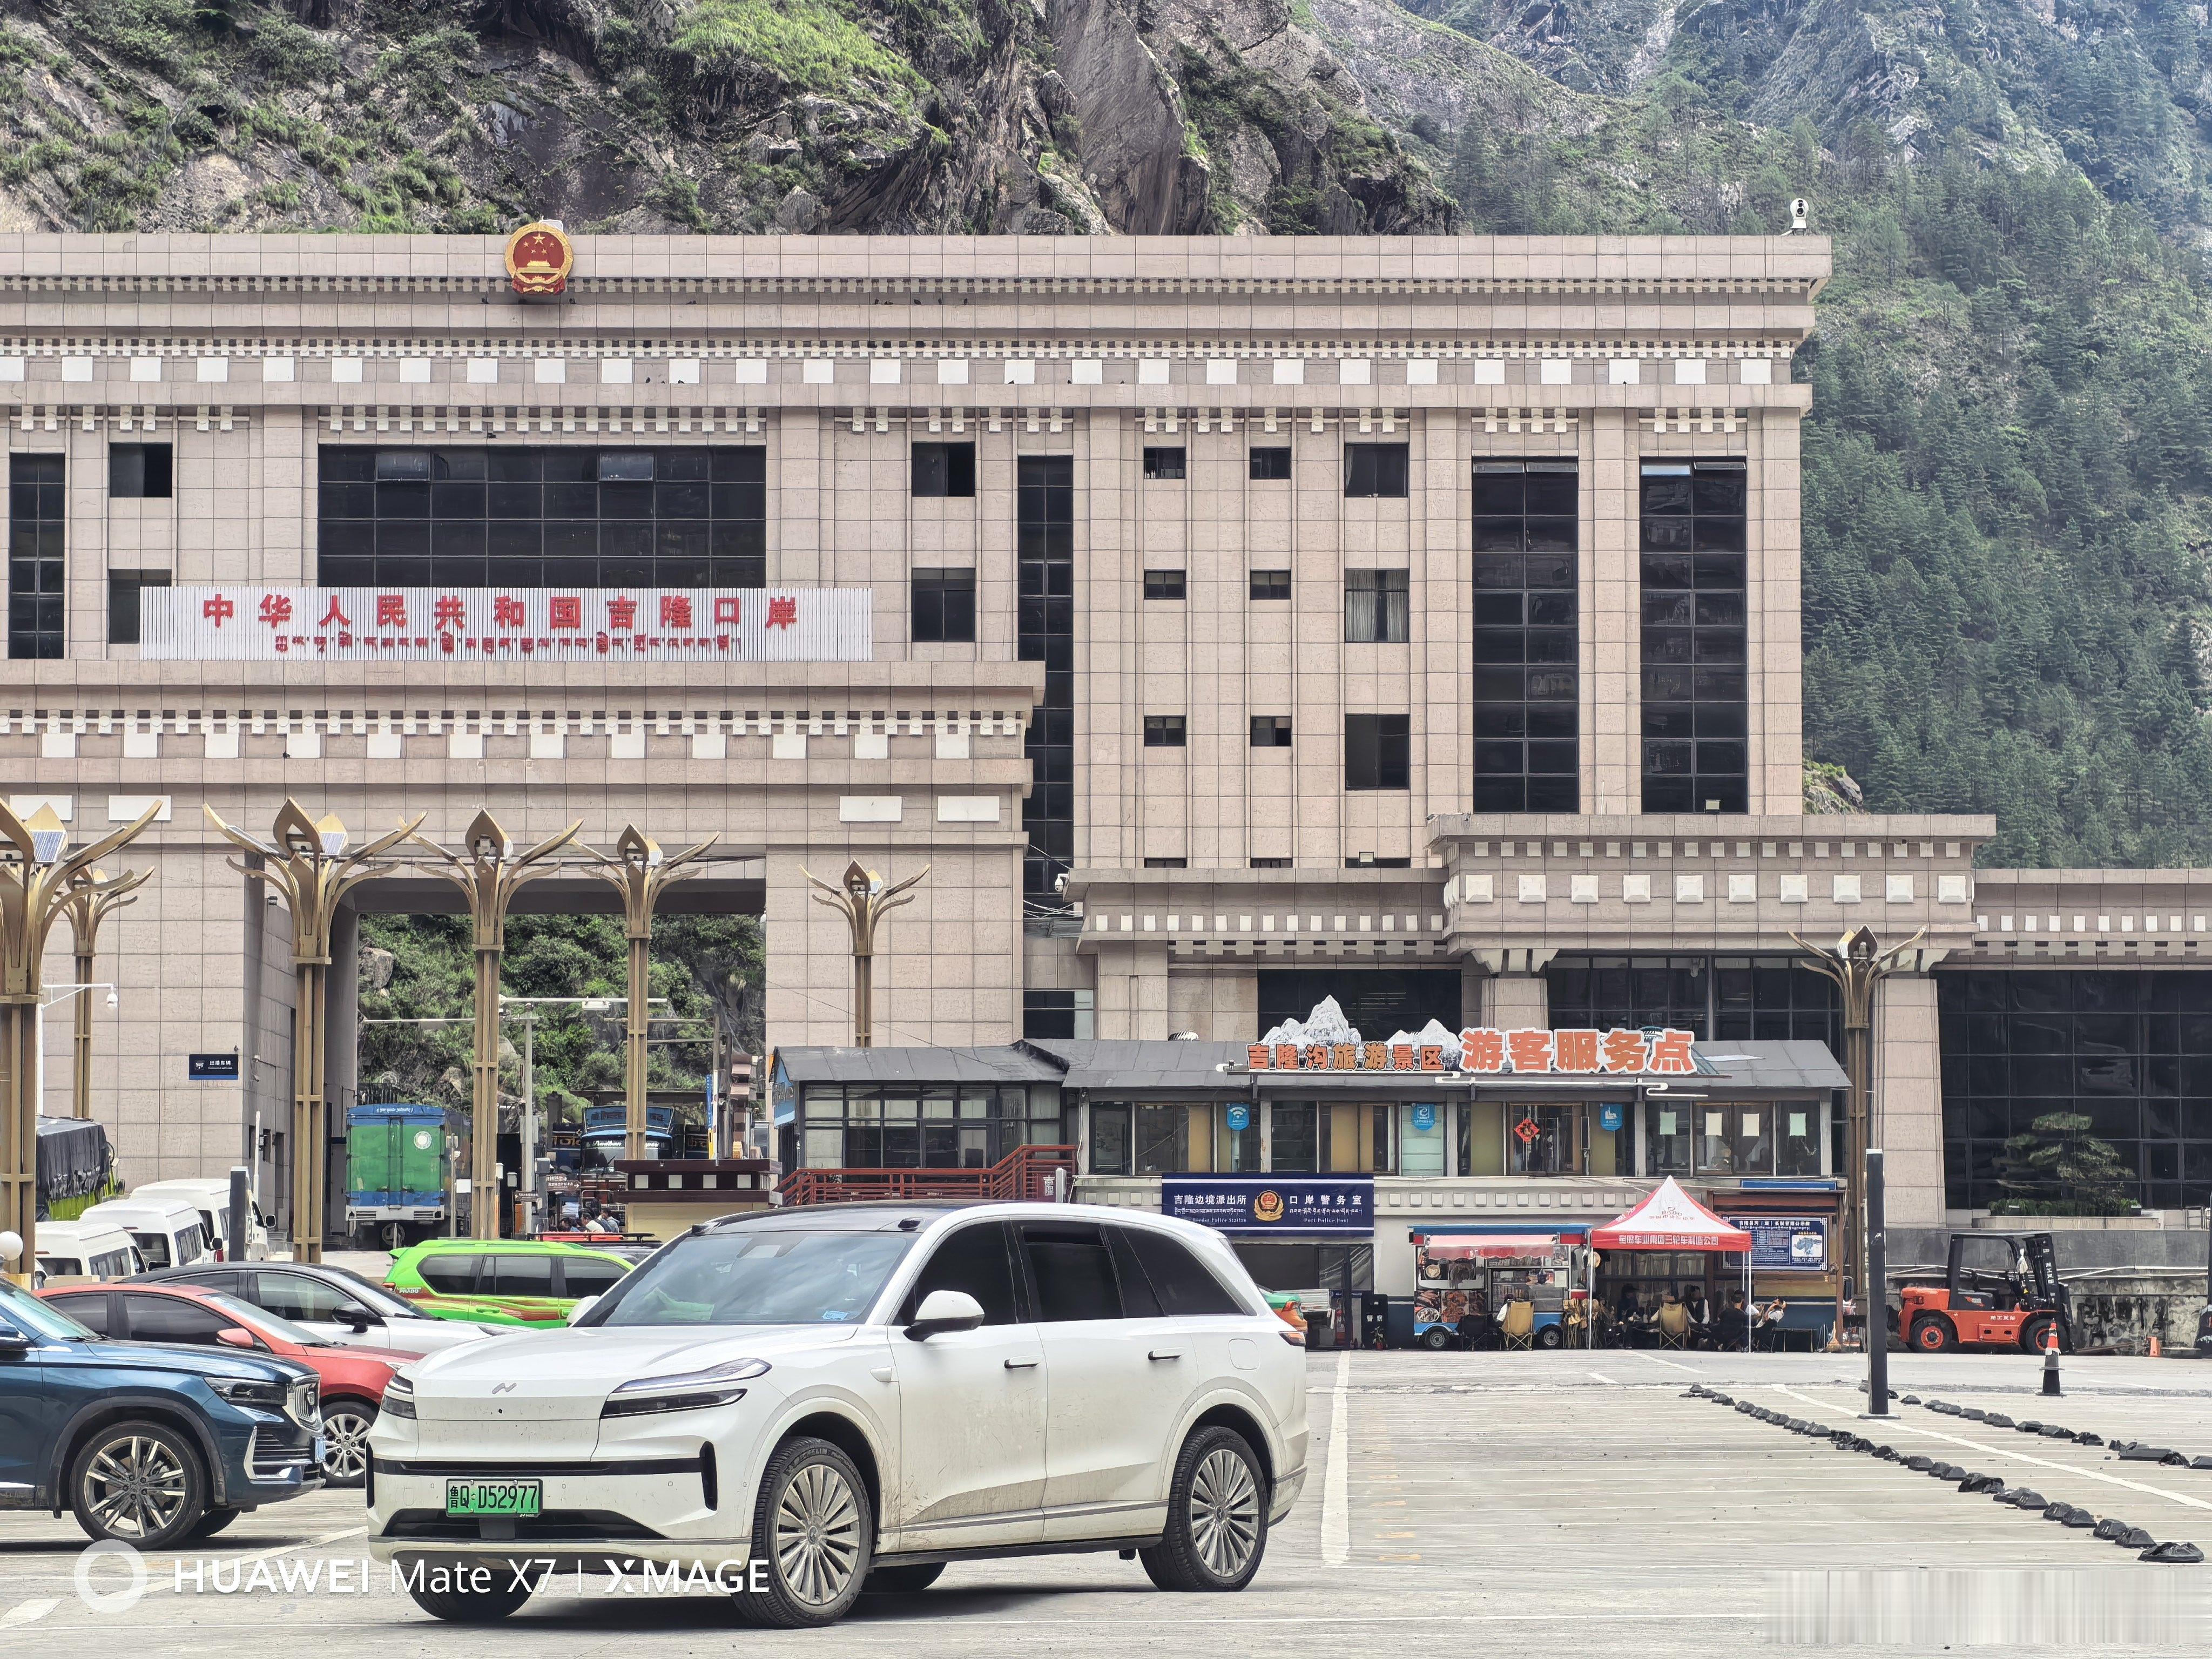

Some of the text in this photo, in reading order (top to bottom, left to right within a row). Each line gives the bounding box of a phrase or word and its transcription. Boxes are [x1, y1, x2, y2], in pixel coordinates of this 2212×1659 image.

[204, 594, 797, 630] 中华人民共和国吉隆口岸
[1246, 1027, 1697, 1075] 吉隆沟旅游景区 游客服务点
[1174, 1195, 1246, 1205] 吉隆边境派出所
[1290, 1195, 1363, 1205] 口岸警务室
